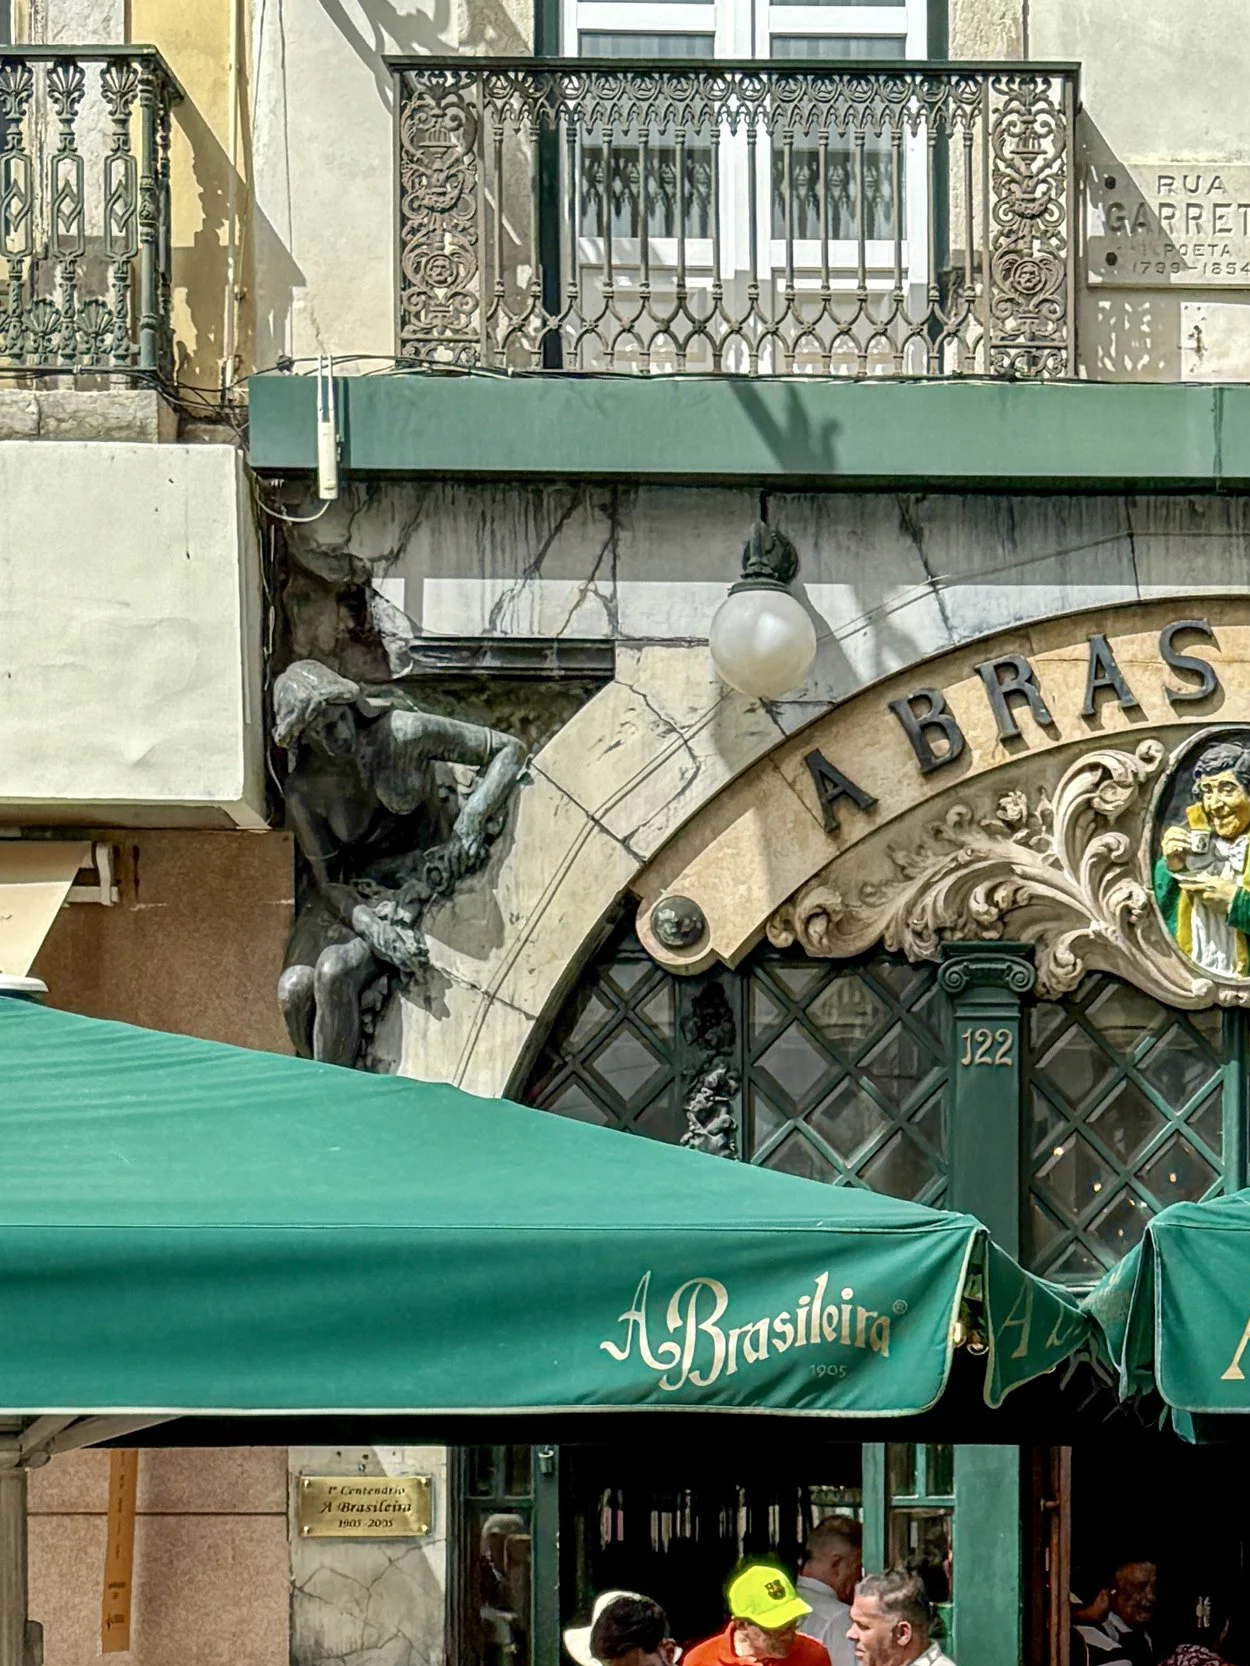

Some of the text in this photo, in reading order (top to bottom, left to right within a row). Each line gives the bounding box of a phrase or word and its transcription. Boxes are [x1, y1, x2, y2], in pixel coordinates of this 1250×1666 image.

[1157, 175, 1226, 195] RUA
[1163, 243, 1231, 257] POETA
[805, 747, 878, 833] A
[961, 1028, 1013, 1066] 122
[600, 1270, 891, 1391] A Brasileira
[809, 1363, 847, 1377] 1905
